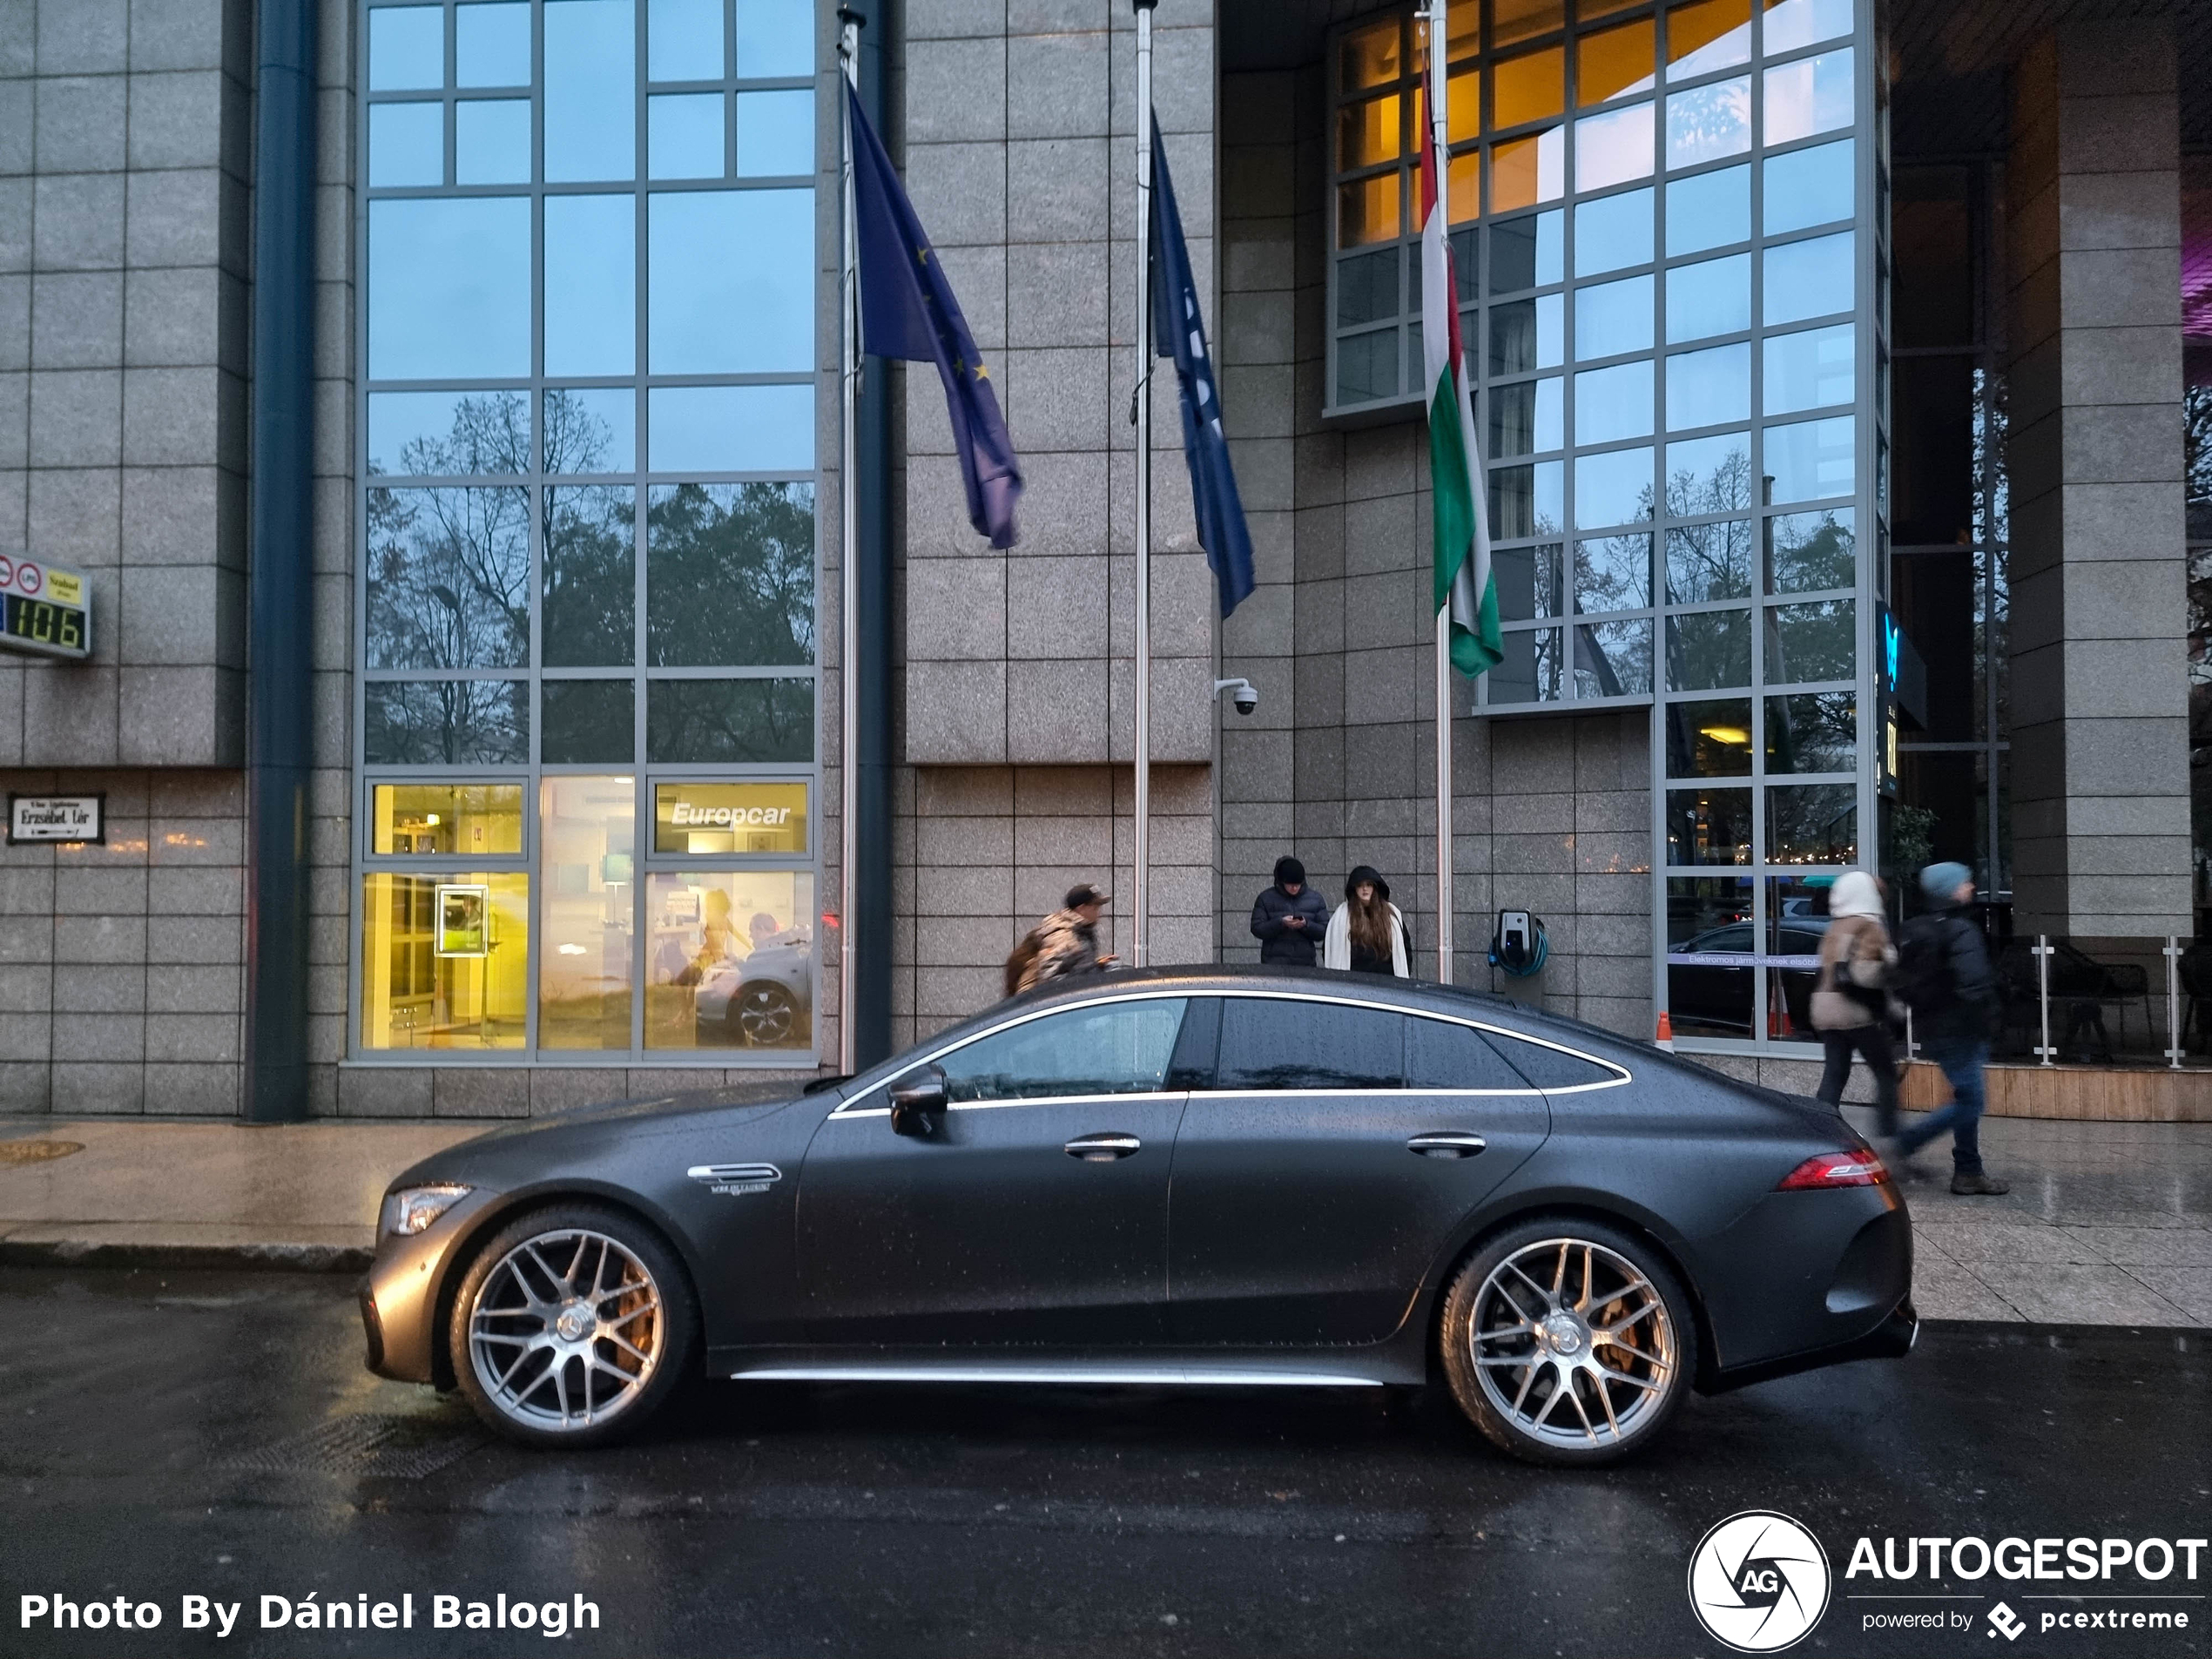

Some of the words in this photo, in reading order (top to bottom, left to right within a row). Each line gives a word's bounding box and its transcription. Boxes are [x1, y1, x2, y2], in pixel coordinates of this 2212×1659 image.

[17, 600, 78, 647] 106
[21, 808, 67, 825] Erzsébet
[671, 802, 791, 832] Europcar
[1689, 954, 1734, 964] Elektromos
[1790, 957, 1820, 966] elsőbb
